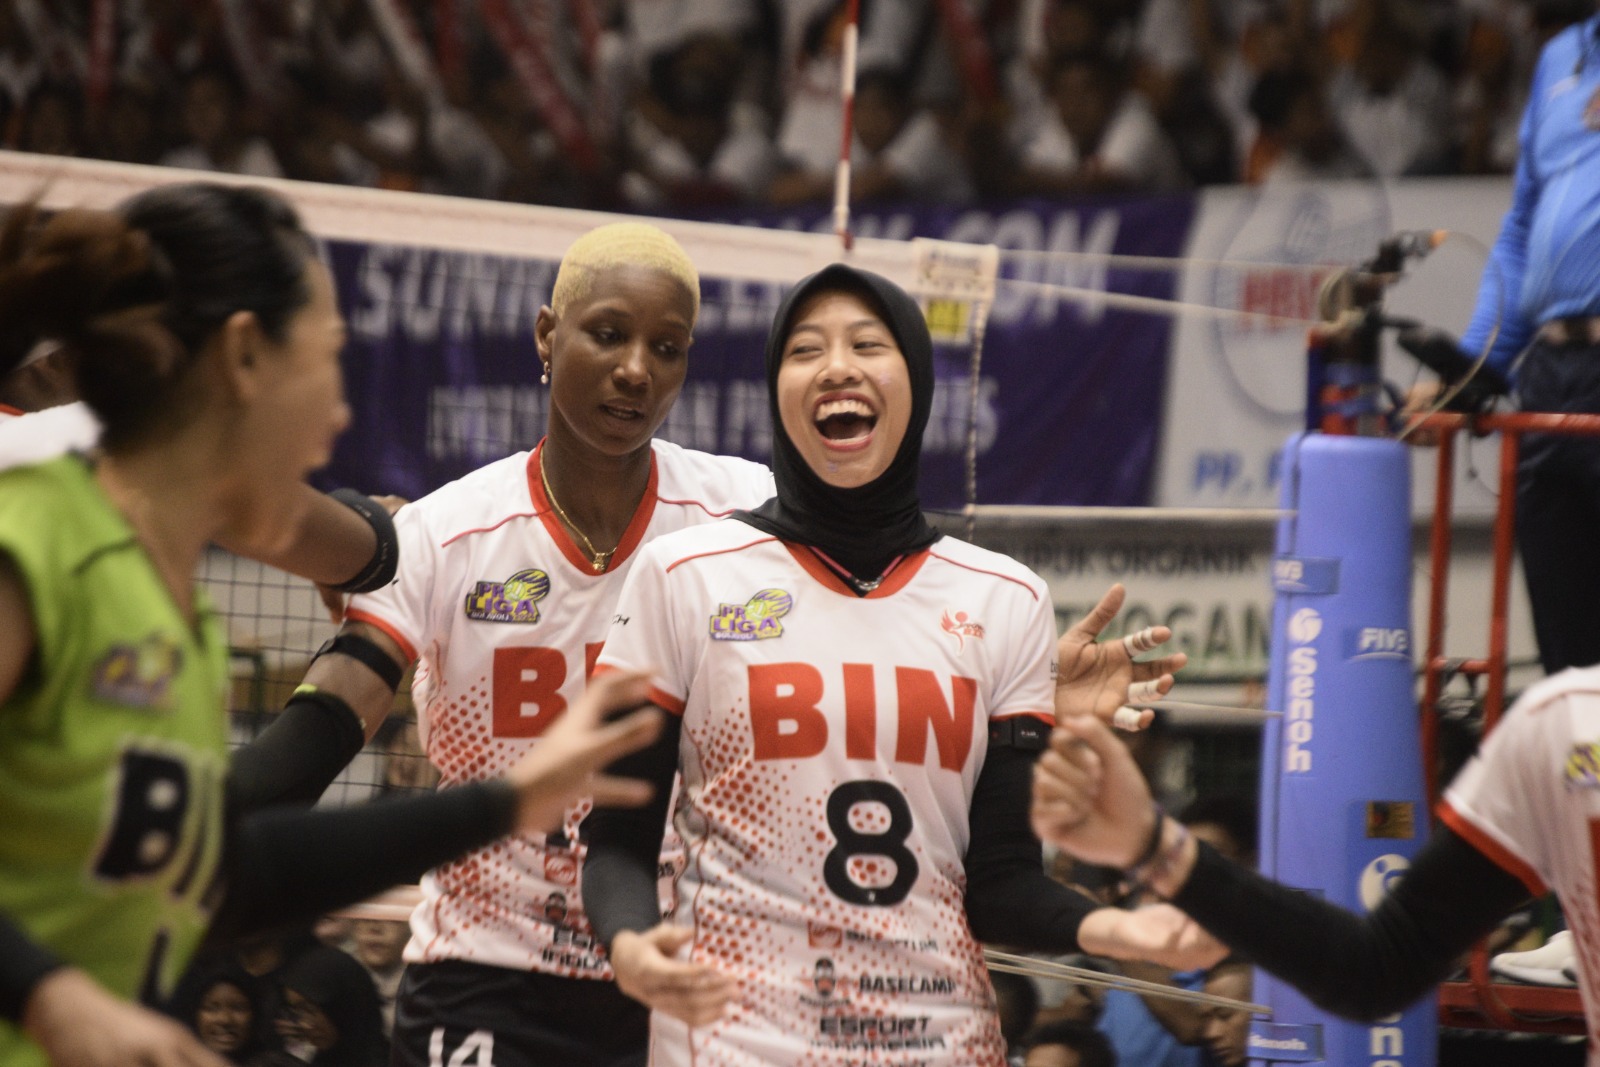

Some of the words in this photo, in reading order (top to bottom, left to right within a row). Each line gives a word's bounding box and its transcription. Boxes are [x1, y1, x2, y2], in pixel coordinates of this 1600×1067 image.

[470, 598, 535, 615] LIGA
[713, 616, 778, 634] LIGA
[747, 662, 978, 774] BIN
[823, 779, 919, 907] 8
[428, 1027, 495, 1067] 14
